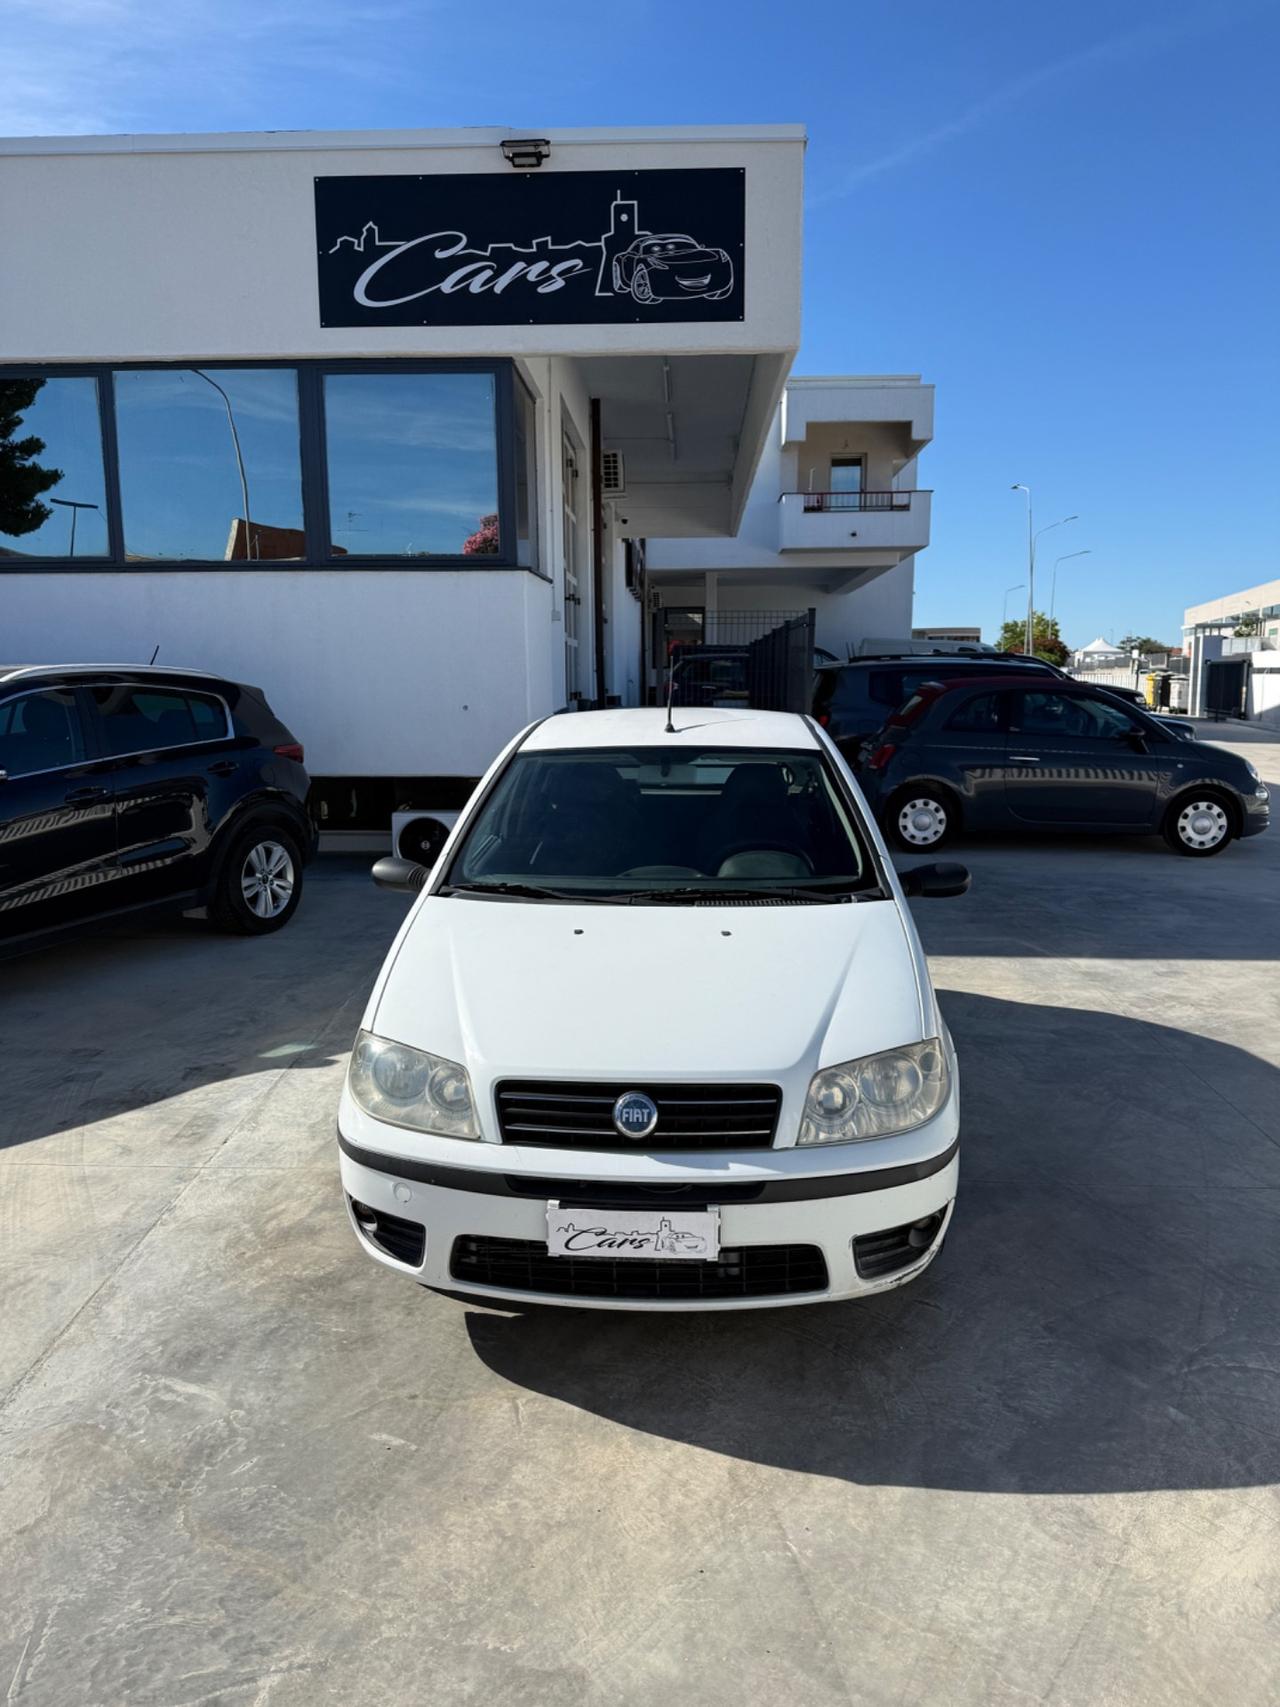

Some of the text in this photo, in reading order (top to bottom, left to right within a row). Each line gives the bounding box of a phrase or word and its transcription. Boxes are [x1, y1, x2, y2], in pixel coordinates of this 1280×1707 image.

[353, 231, 592, 308] Cars
[622, 1108, 650, 1123] FIAT
[564, 1227, 652, 1251] Cars
